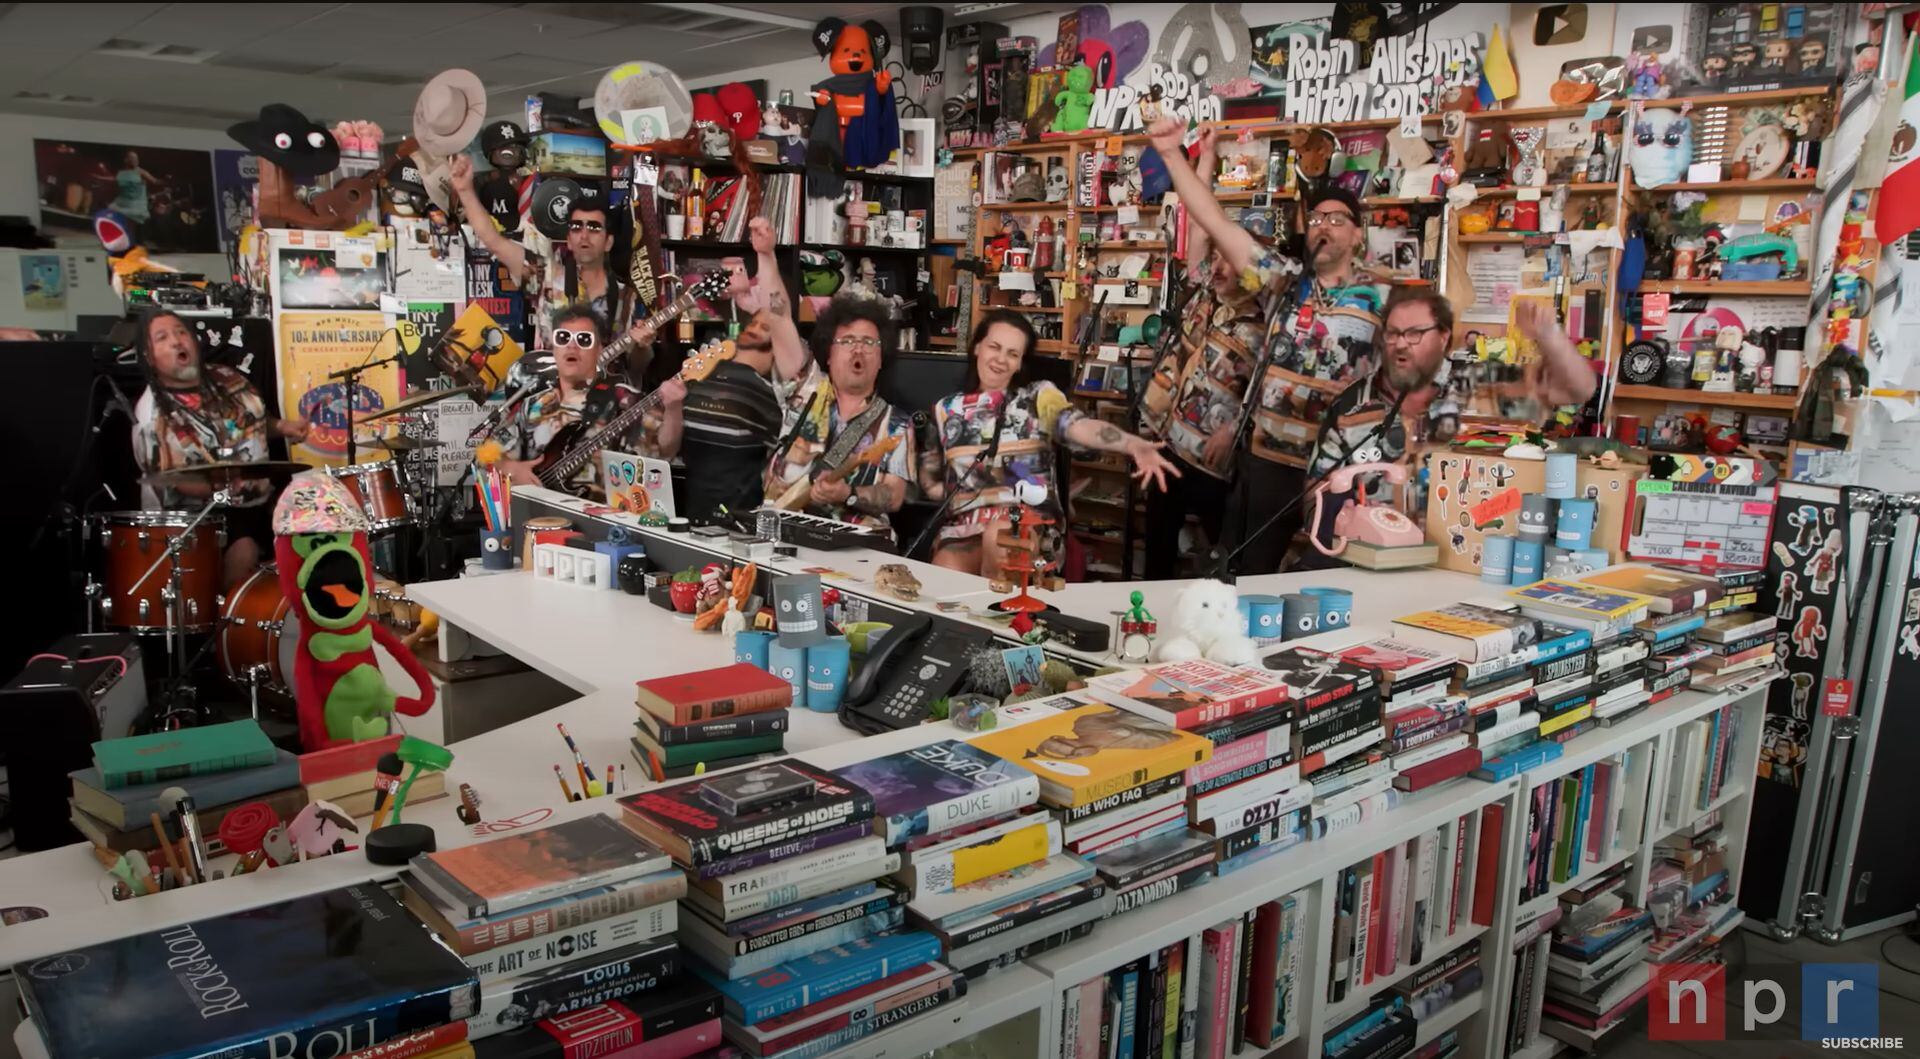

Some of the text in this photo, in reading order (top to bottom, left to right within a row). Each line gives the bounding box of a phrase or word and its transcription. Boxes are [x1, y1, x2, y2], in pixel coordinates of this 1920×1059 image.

[1287, 32, 1355, 80] Robin
[1150, 63, 1188, 100] Bob
[1088, 85, 1146, 131] NPR
[1161, 82, 1222, 122] Boilen
[1285, 74, 1367, 124] Hilton
[492, 199, 508, 213] M
[404, 323, 440, 337] BUT-
[1546, 653, 1586, 680] SPRINGSTEEN
[1311, 693, 1332, 710] HARD
[1331, 683, 1355, 700] STUFF
[1306, 727, 1358, 755] JOHNNY CASH FAQ
[1406, 730, 1435, 748] COUNTRY
[914, 745, 1011, 786] DUKE
[947, 794, 993, 820] DUKE
[1072, 787, 1143, 820] THE WHO FAQ
[1242, 798, 1281, 828] OZZY
[717, 817, 790, 851] QUEENS
[804, 801, 854, 826] NOISE
[769, 841, 801, 859] BELIEVE
[1117, 873, 1179, 914] ALTAMONT
[1362, 881, 1371, 899] David
[1360, 900, 1369, 921] Bowie
[493, 922, 510, 945] TAKE
[513, 917, 529, 937] YOU
[749, 928, 789, 952] FORGOTTEN
[788, 923, 805, 939] FADS
[815, 910, 846, 931] FABULOUS
[968, 919, 1015, 942] SHOW POSTERS
[499, 950, 525, 974] ART
[528, 950, 542, 961] OF
[546, 930, 598, 961] NOISE
[1356, 953, 1365, 976] There
[583, 962, 632, 987] LOUIS
[1418, 957, 1458, 985] NIRVANA FAQ
[557, 977, 657, 1014] ARMSTRONG
[866, 993, 941, 1033] STRANGERS
[266, 1018, 388, 1059] ROLL
[1101, 1024, 1109, 1042] DIY
